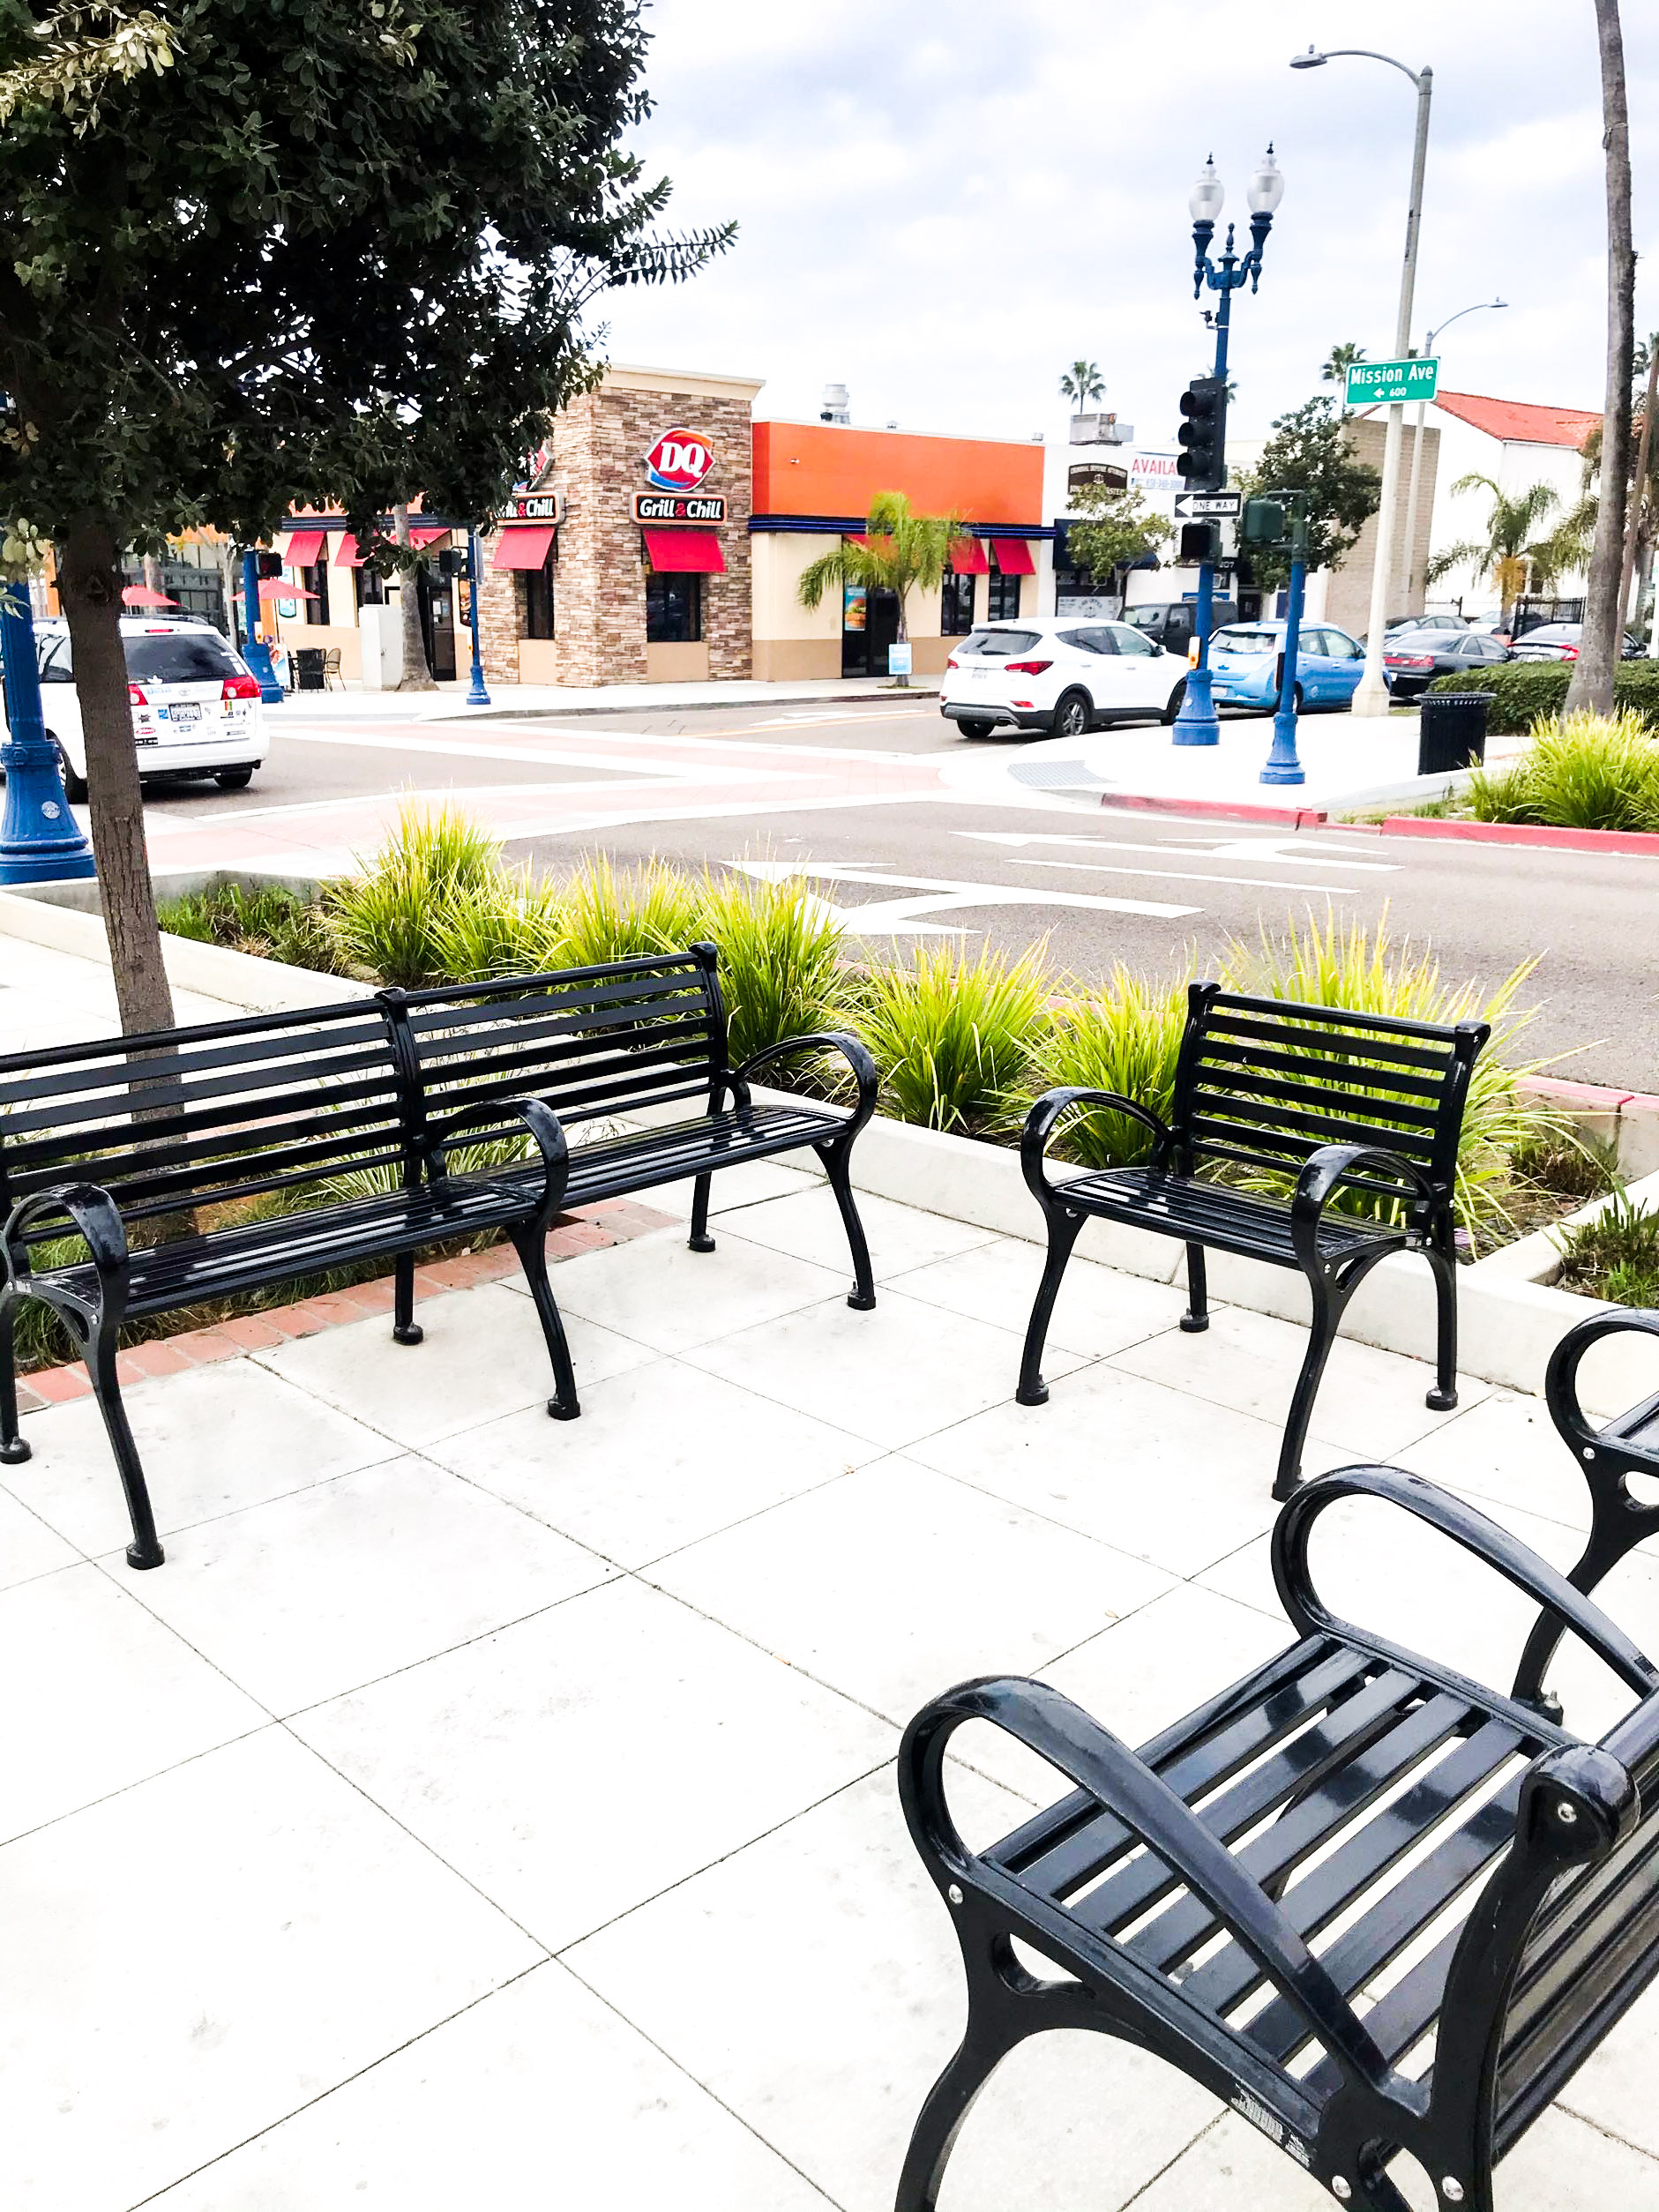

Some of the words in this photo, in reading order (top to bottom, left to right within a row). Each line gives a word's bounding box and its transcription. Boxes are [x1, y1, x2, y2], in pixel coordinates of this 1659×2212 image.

[1350, 366, 1403, 385] Mission
[1408, 364, 1434, 381] Ave
[1388, 386, 1407, 397] 600
[658, 441, 706, 477] DQ
[1131, 458, 1180, 476] AVAILA
[1192, 501, 1211, 510] ONE
[1215, 500, 1235, 510] WAY
